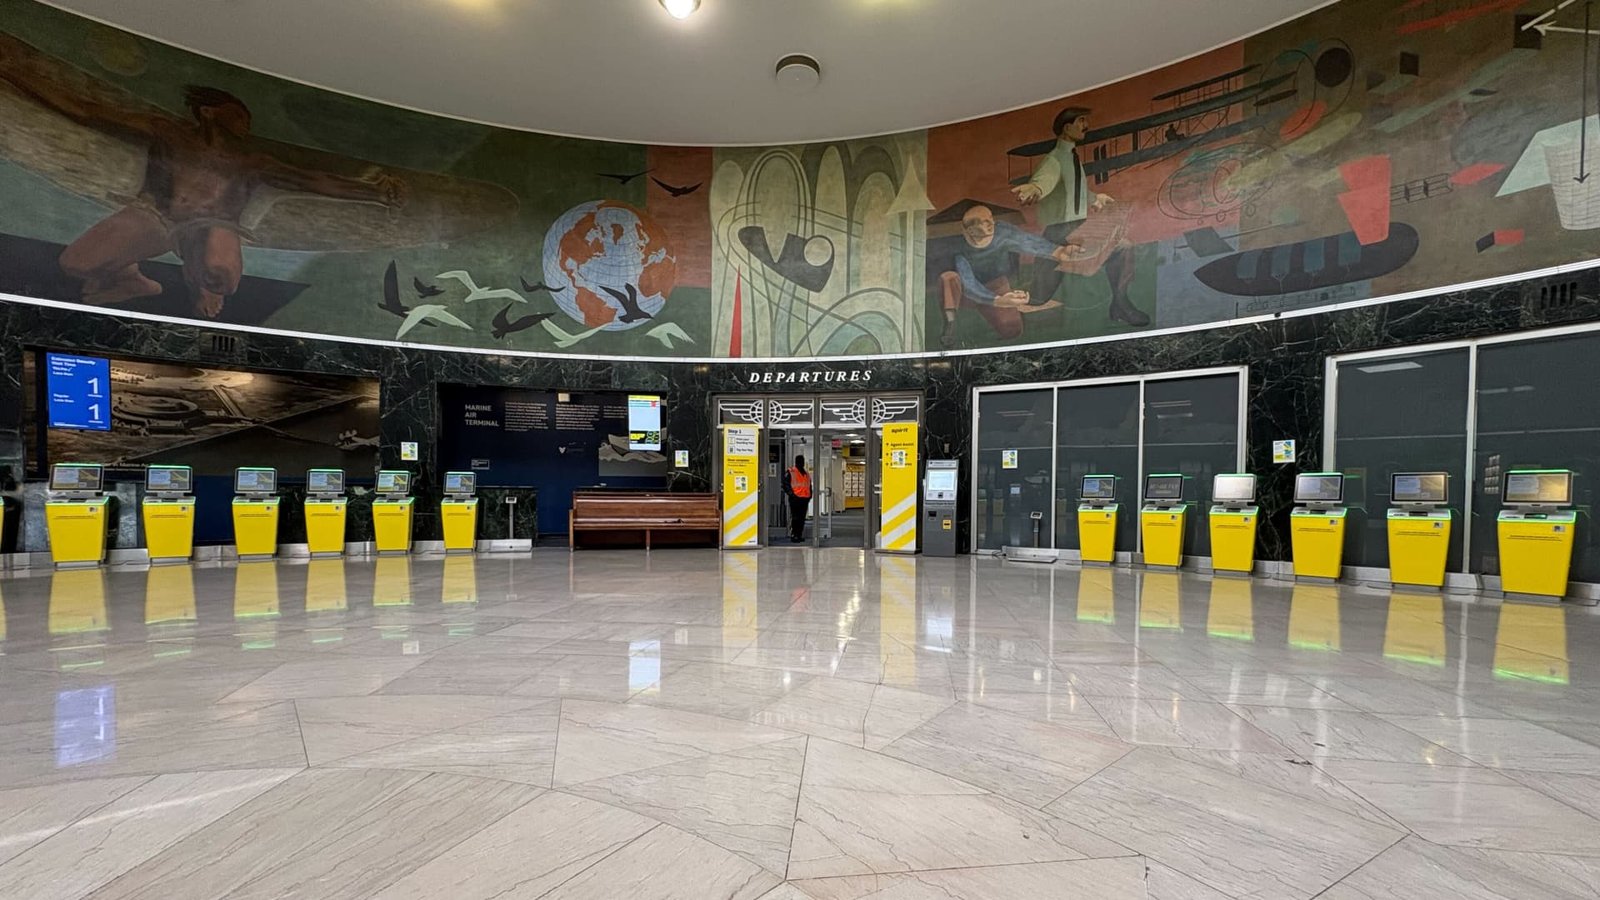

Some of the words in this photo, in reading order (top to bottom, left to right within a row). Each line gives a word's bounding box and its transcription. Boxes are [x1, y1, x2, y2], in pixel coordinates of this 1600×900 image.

[749, 370, 872, 383] DEPARTURES
[87, 377, 98, 394] 1
[88, 403, 99, 420] 1
[464, 419, 500, 427] TERMINAL
